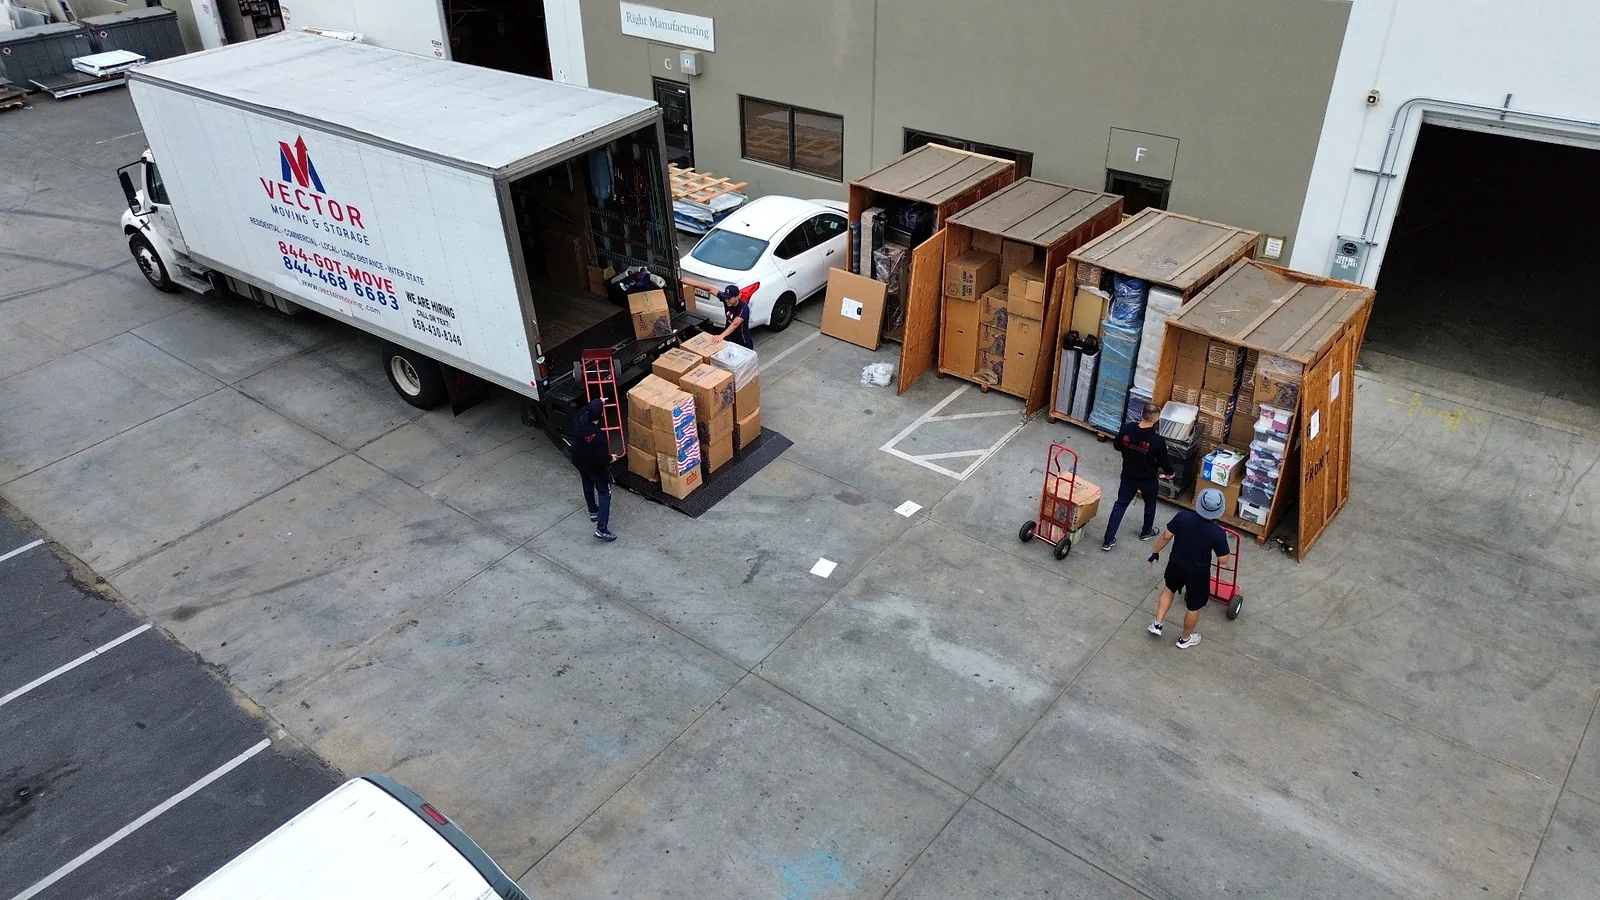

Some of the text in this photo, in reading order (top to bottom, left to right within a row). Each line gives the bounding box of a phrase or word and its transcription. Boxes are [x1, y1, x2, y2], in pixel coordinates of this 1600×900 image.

[625, 11, 710, 40] Right Manufacturing
[1135, 147, 1147, 161] F
[259, 176, 365, 230] VECTOR
[270, 204, 370, 246] MOVING & STORAGE
[278, 240, 395, 295] 844-GOT-MOVE
[283, 255, 399, 310] 844-468 6683
[356, 254, 384, 271] DISTANCE
[405, 272, 425, 286] STATE
[405, 290, 456, 319] WE ARE HIRING
[416, 309, 429, 320] CALL
[429, 314, 437, 323] OR
[1304, 450, 1330, 488] FRONT
